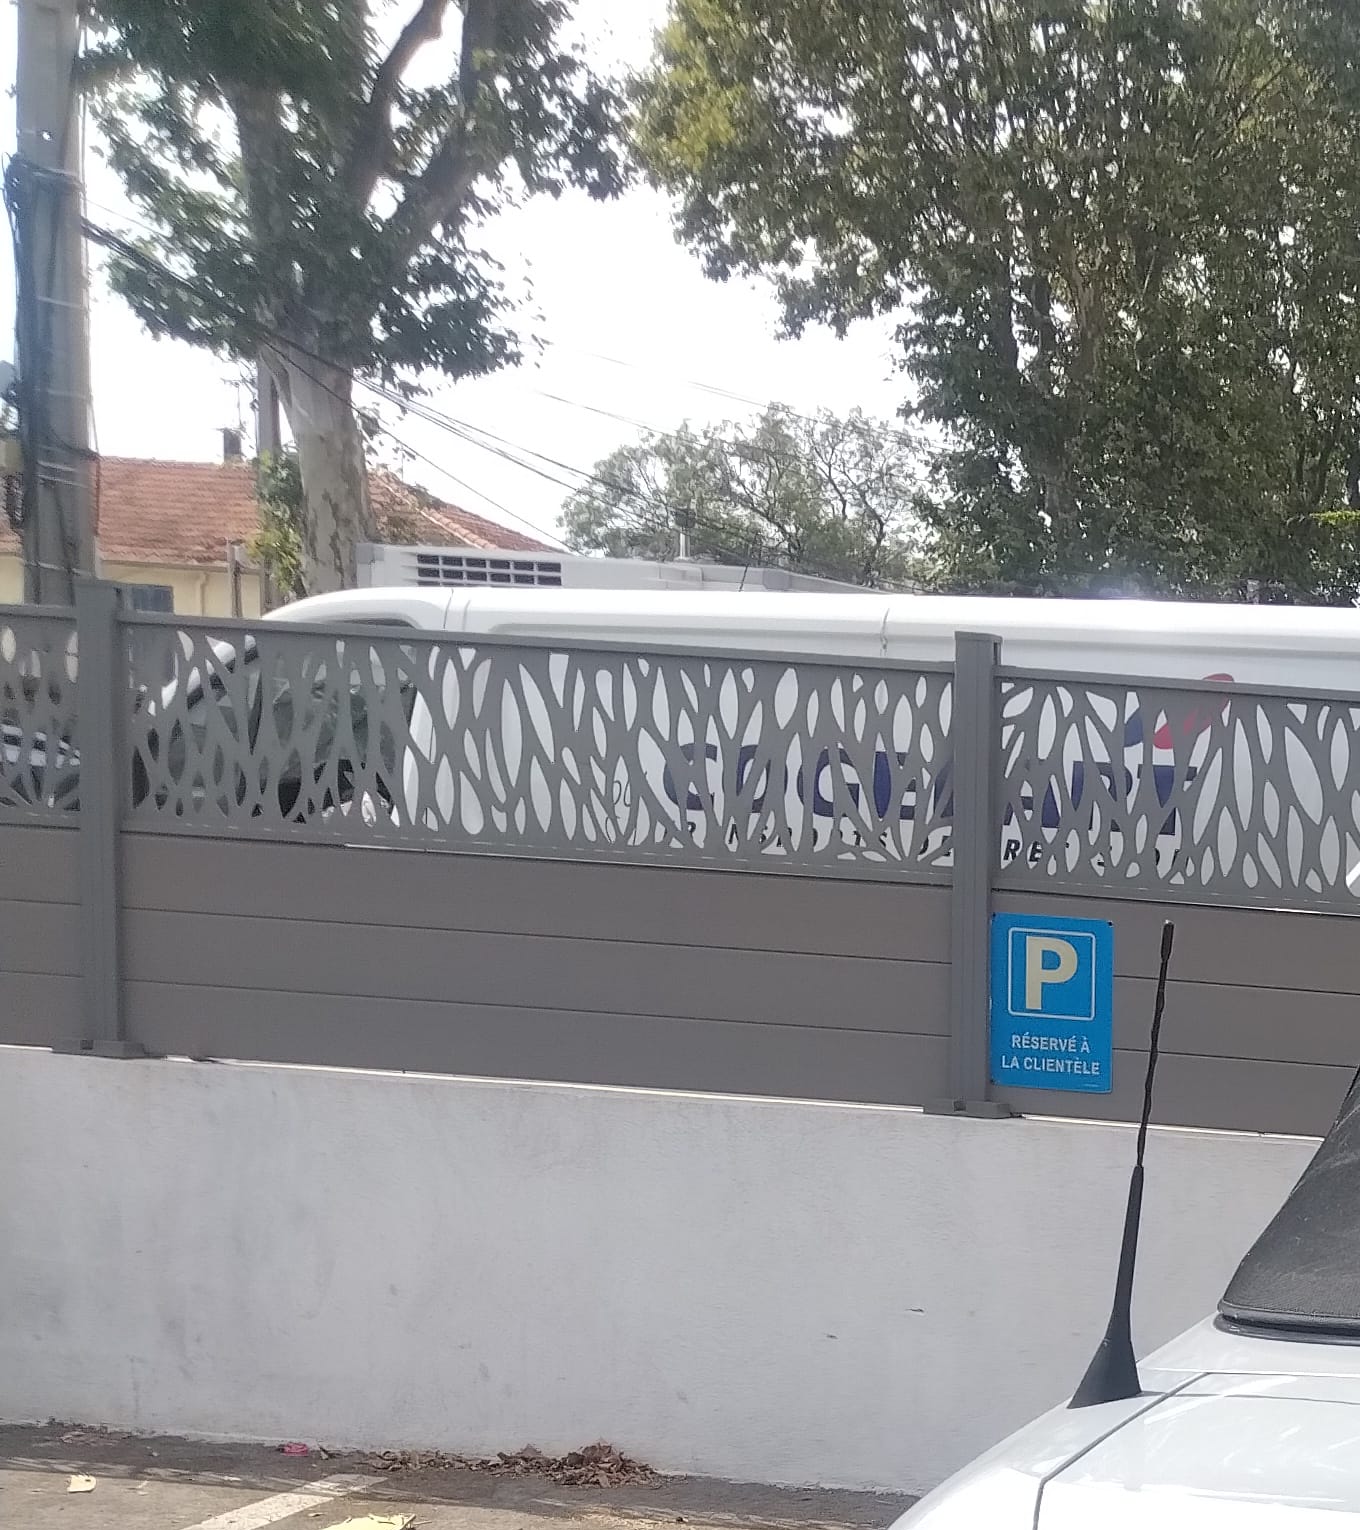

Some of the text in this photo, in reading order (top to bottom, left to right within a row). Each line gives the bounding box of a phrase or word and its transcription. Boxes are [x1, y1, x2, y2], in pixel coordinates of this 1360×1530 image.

[1026, 936, 1078, 1010] P
[1011, 1032, 1091, 1053] RÉSERVÉ À
[1001, 1055, 1101, 1076] LA CLIENTÈLE
